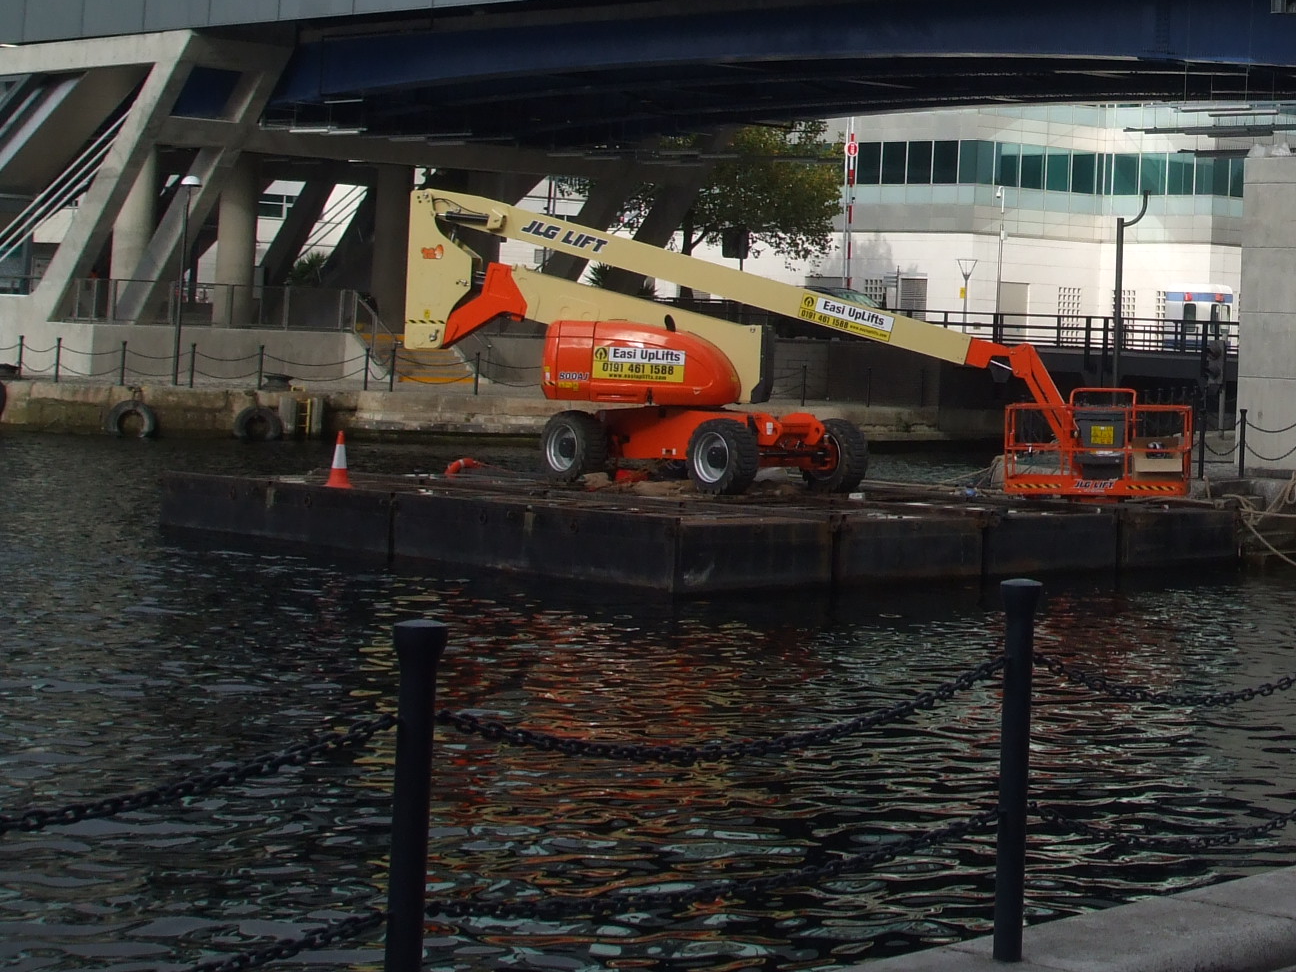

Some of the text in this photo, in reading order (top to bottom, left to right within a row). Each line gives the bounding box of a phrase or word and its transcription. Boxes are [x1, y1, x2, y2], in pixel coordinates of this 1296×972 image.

[521, 220, 608, 253] JLG LIFT
[801, 309, 816, 318] 0191
[818, 314, 830, 324] 461
[832, 318, 849, 329] 1588
[823, 300, 885, 326] Easi UpLifts
[612, 348, 681, 362] Easi UpLifts
[602, 362, 674, 375] 0191 461 1588
[559, 372, 590, 381] 800AJ
[1074, 480, 1115, 489] JLG LIFT
